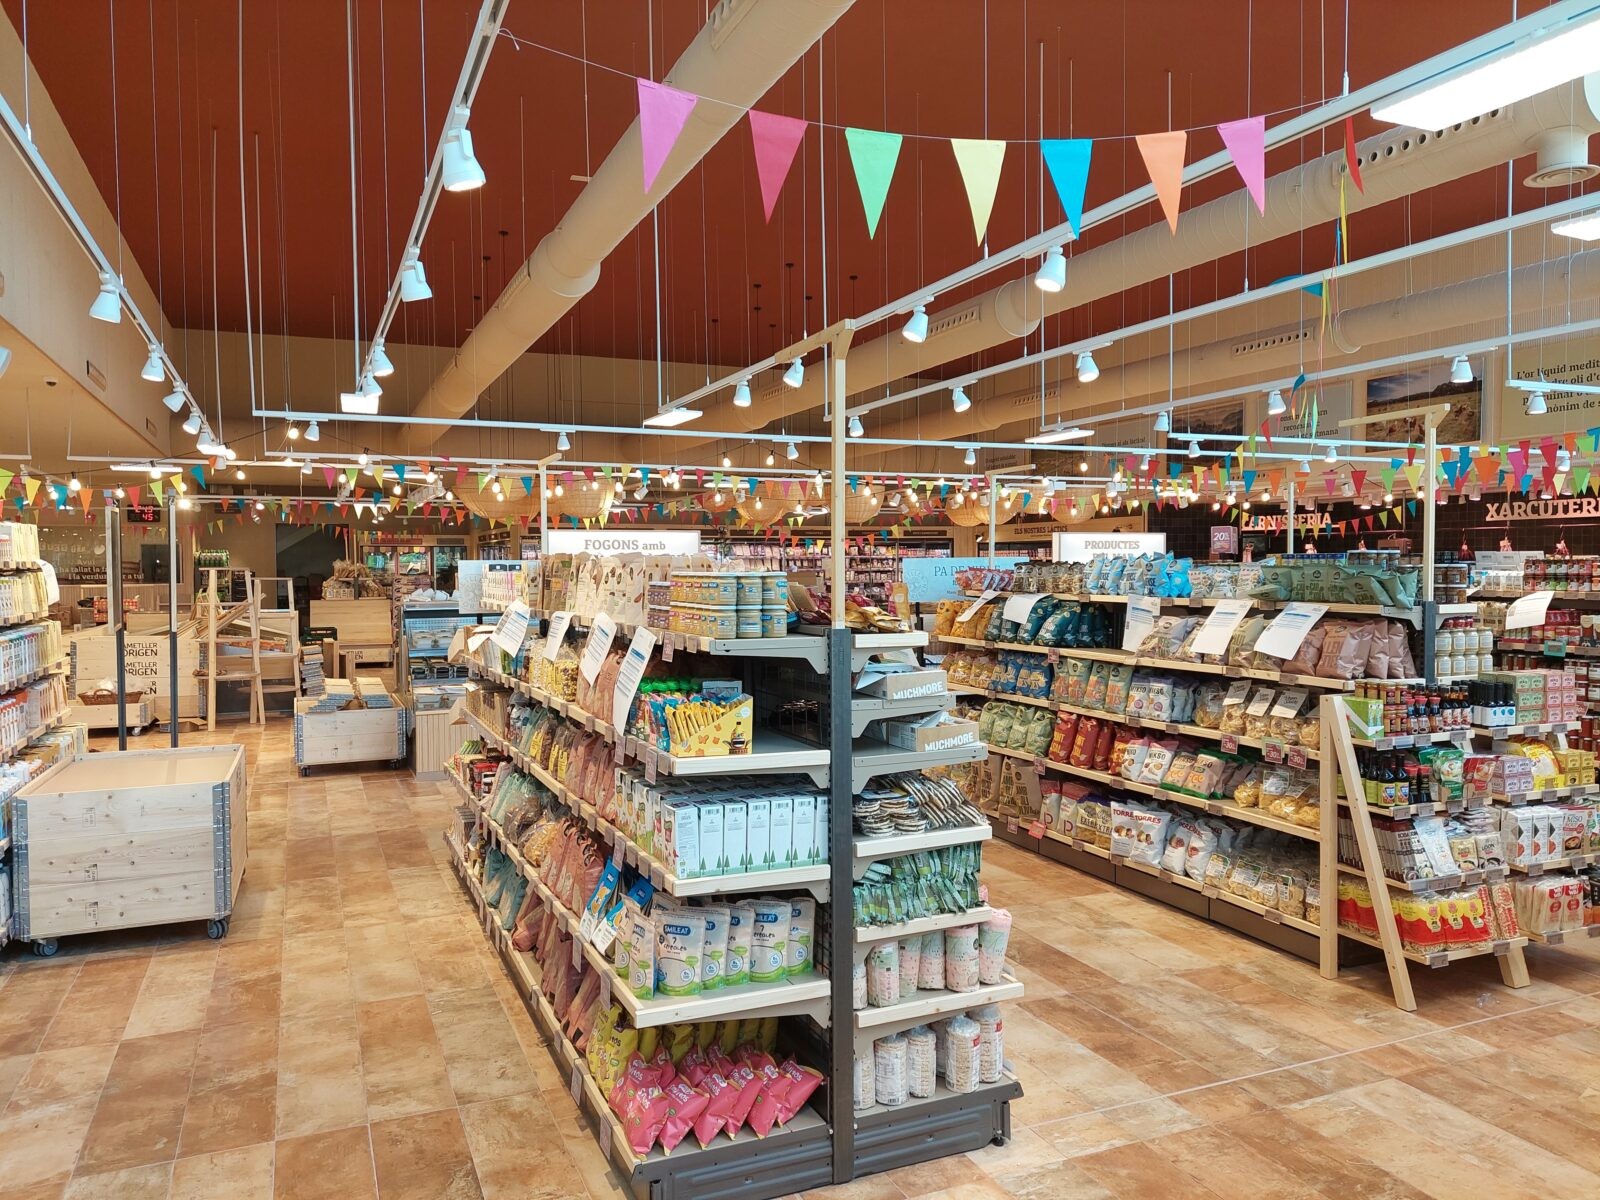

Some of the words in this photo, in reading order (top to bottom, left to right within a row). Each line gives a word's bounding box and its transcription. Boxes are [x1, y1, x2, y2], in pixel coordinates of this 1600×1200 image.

[584, 540, 638, 550] FOGONS
[642, 540, 666, 550] amb
[1084, 540, 1140, 550] PRODUCTES
[934, 566, 948, 576] PA
[893, 681, 944, 700] MUCHMORE
[924, 732, 974, 752] MUCHMORE
[1134, 815, 1162, 824] TORRES
[664, 924, 688, 934] SMILEAT
